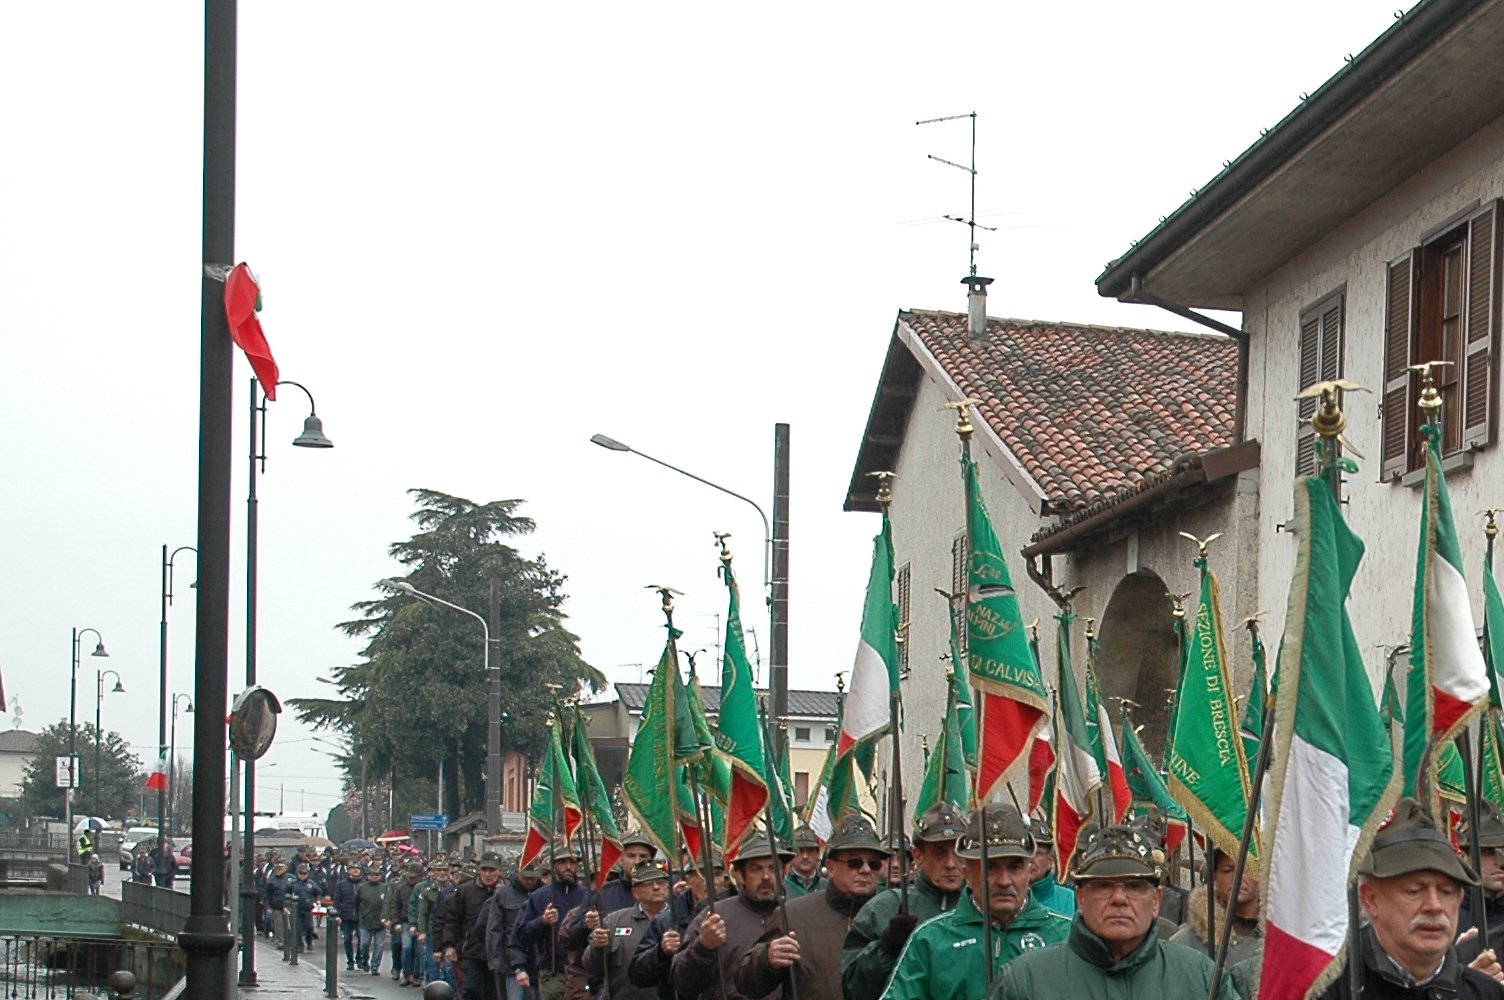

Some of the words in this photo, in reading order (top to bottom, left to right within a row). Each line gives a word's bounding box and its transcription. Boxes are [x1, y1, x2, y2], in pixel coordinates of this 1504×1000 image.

[1196, 602, 1217, 670] SEZIONE
[1205, 676, 1220, 692] DI
[1209, 700, 1232, 767] BRESCIA
